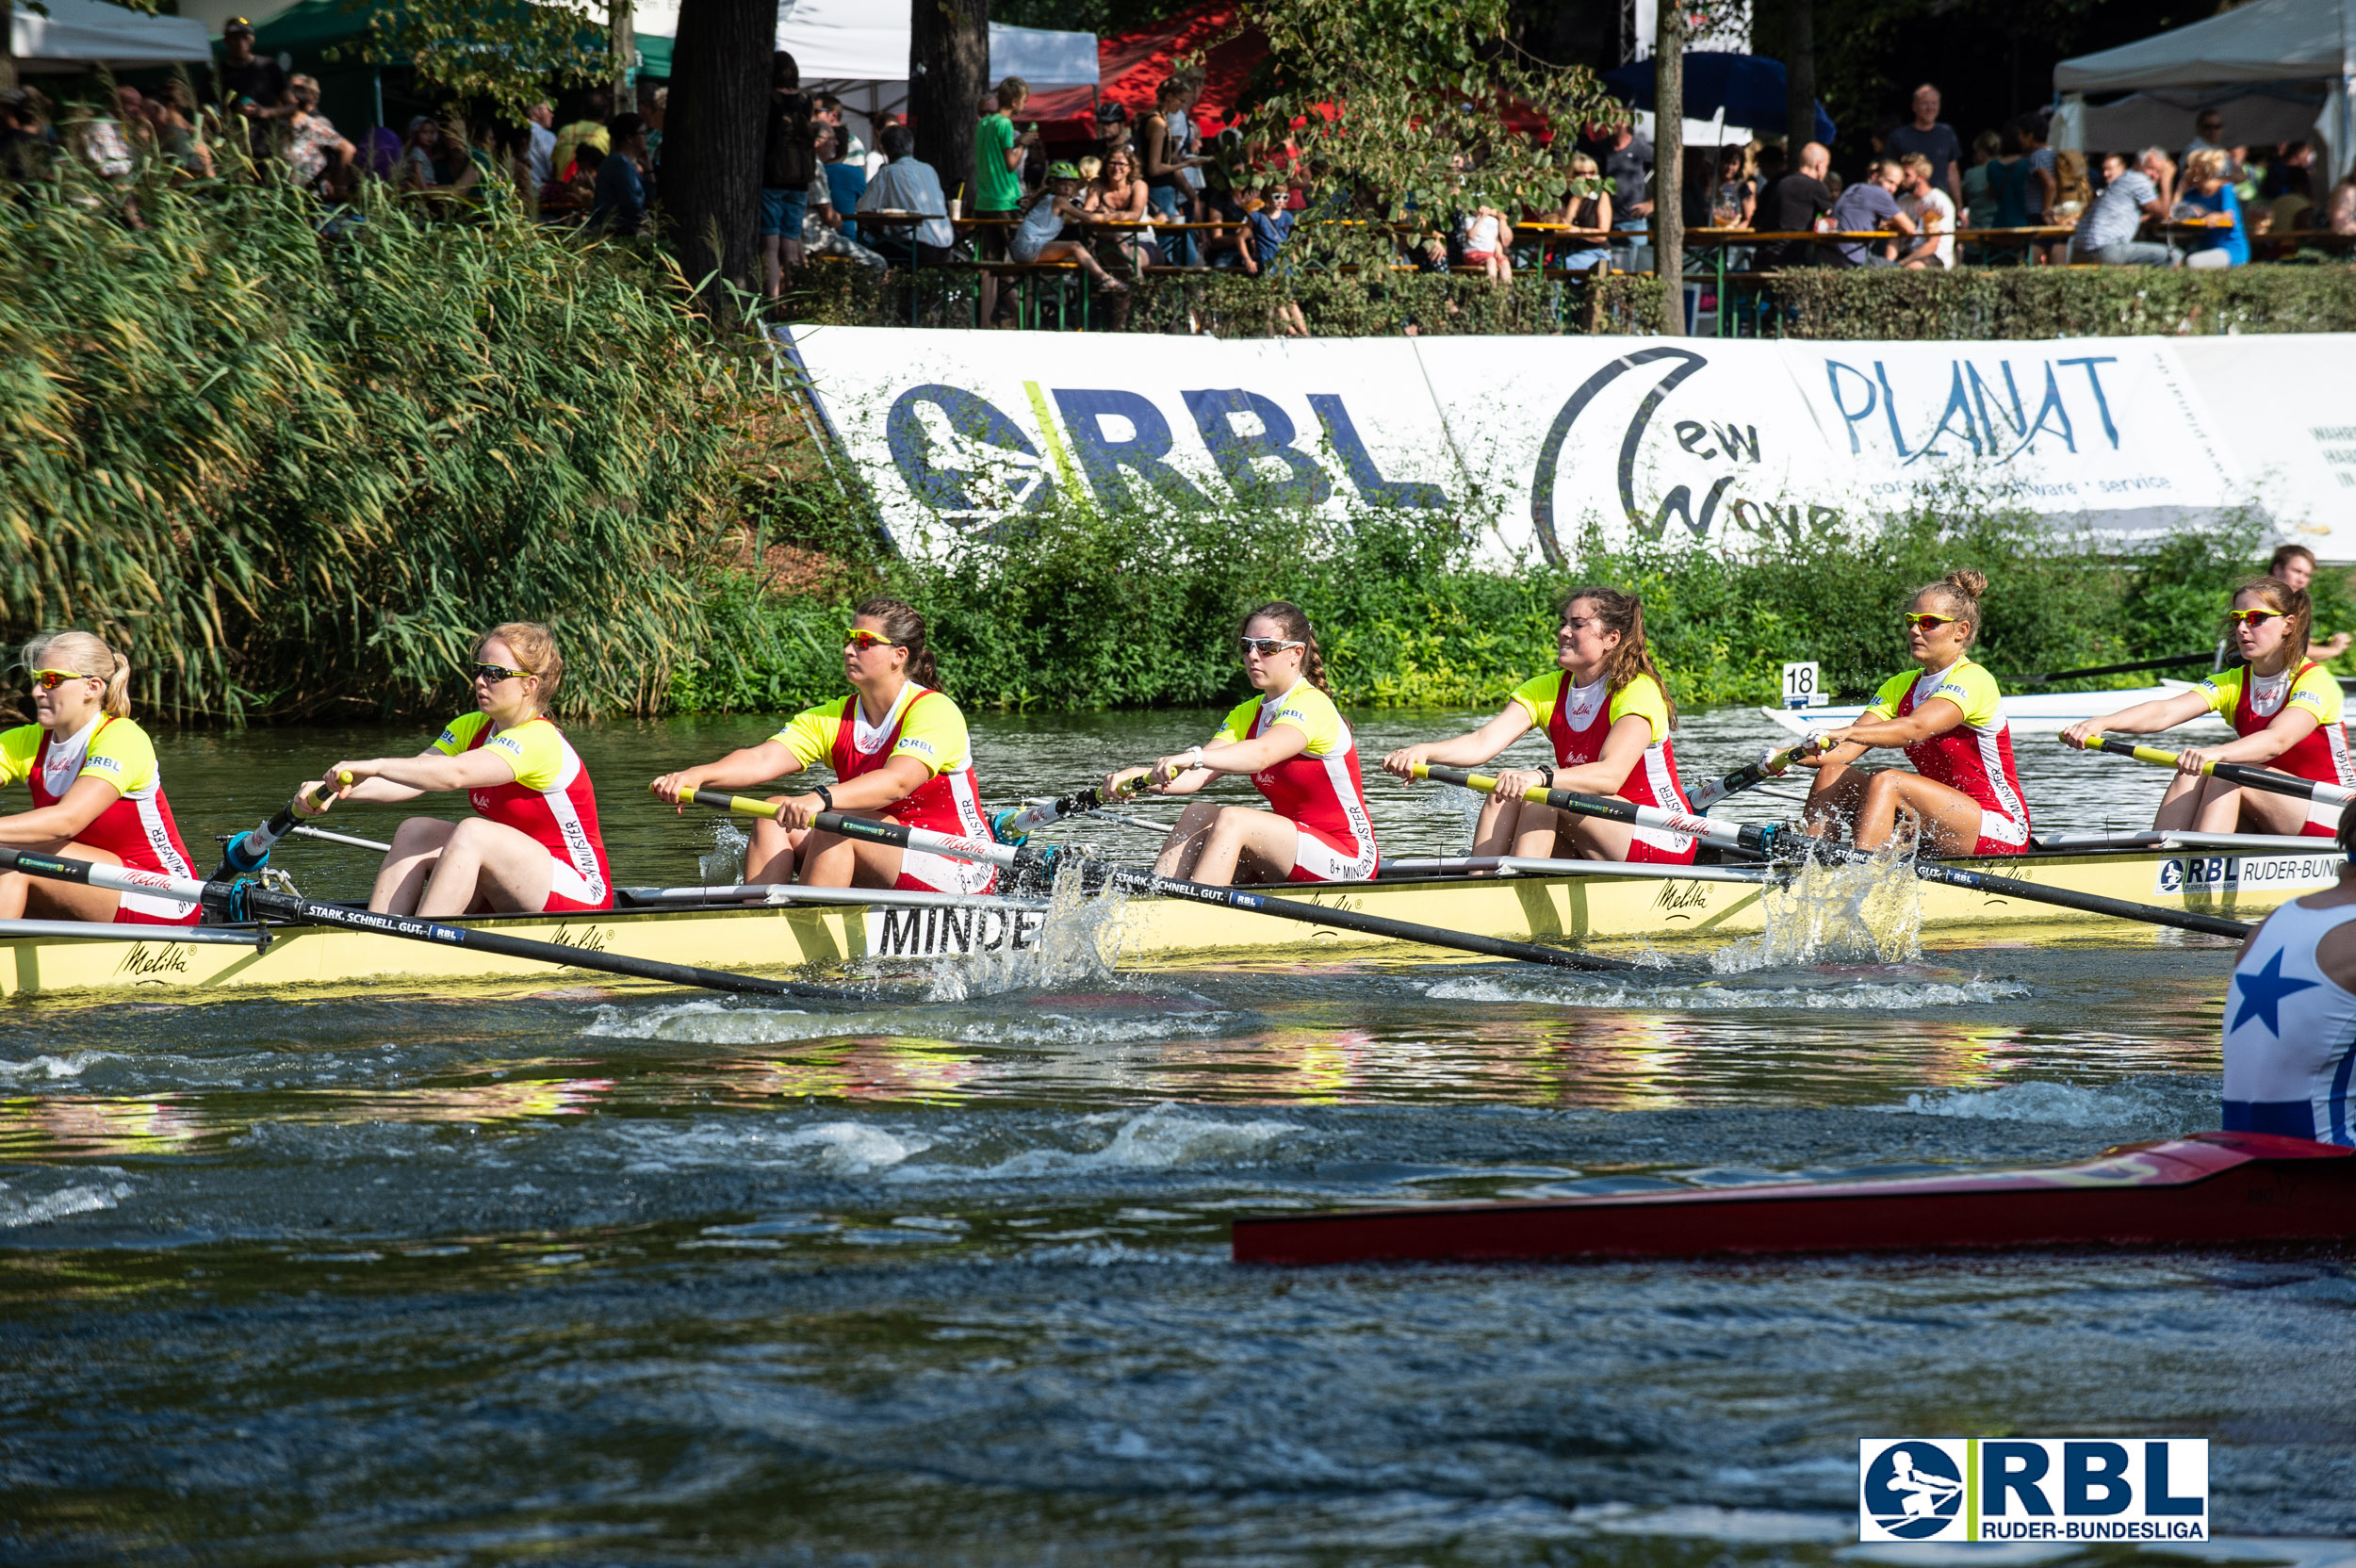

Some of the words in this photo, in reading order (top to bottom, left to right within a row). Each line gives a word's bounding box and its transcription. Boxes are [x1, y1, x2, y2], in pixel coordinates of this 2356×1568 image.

[1825, 356, 2119, 466] PLANAT
[1052, 387, 1450, 510] RBL
[2098, 473, 2171, 494] service
[1787, 667, 1813, 694] 18
[1945, 685, 1967, 698] RBL
[2299, 692, 2321, 705] RBL
[1283, 710, 1304, 722] RBL
[499, 737, 521, 755] RBL
[910, 739, 934, 754] RBL
[94, 757, 121, 772] RBL
[1660, 813, 1711, 838] Melitta
[934, 835, 986, 856] Melitta
[1330, 858, 1341, 874] 8+
[2185, 858, 2239, 884] RBL
[2243, 858, 2347, 881] RUDER-BUND
[116, 869, 173, 892] Melitta
[1954, 872, 1972, 883] RBL
[1201, 888, 1224, 902] GUT.
[1237, 895, 1256, 906] RBL
[1650, 878, 1708, 911] Melitta
[309, 906, 345, 922] STARK.
[347, 912, 397, 931] SCHNELL.
[436, 928, 457, 939] RBL
[879, 908, 1047, 956] MINDE
[114, 940, 188, 976] Melitta
